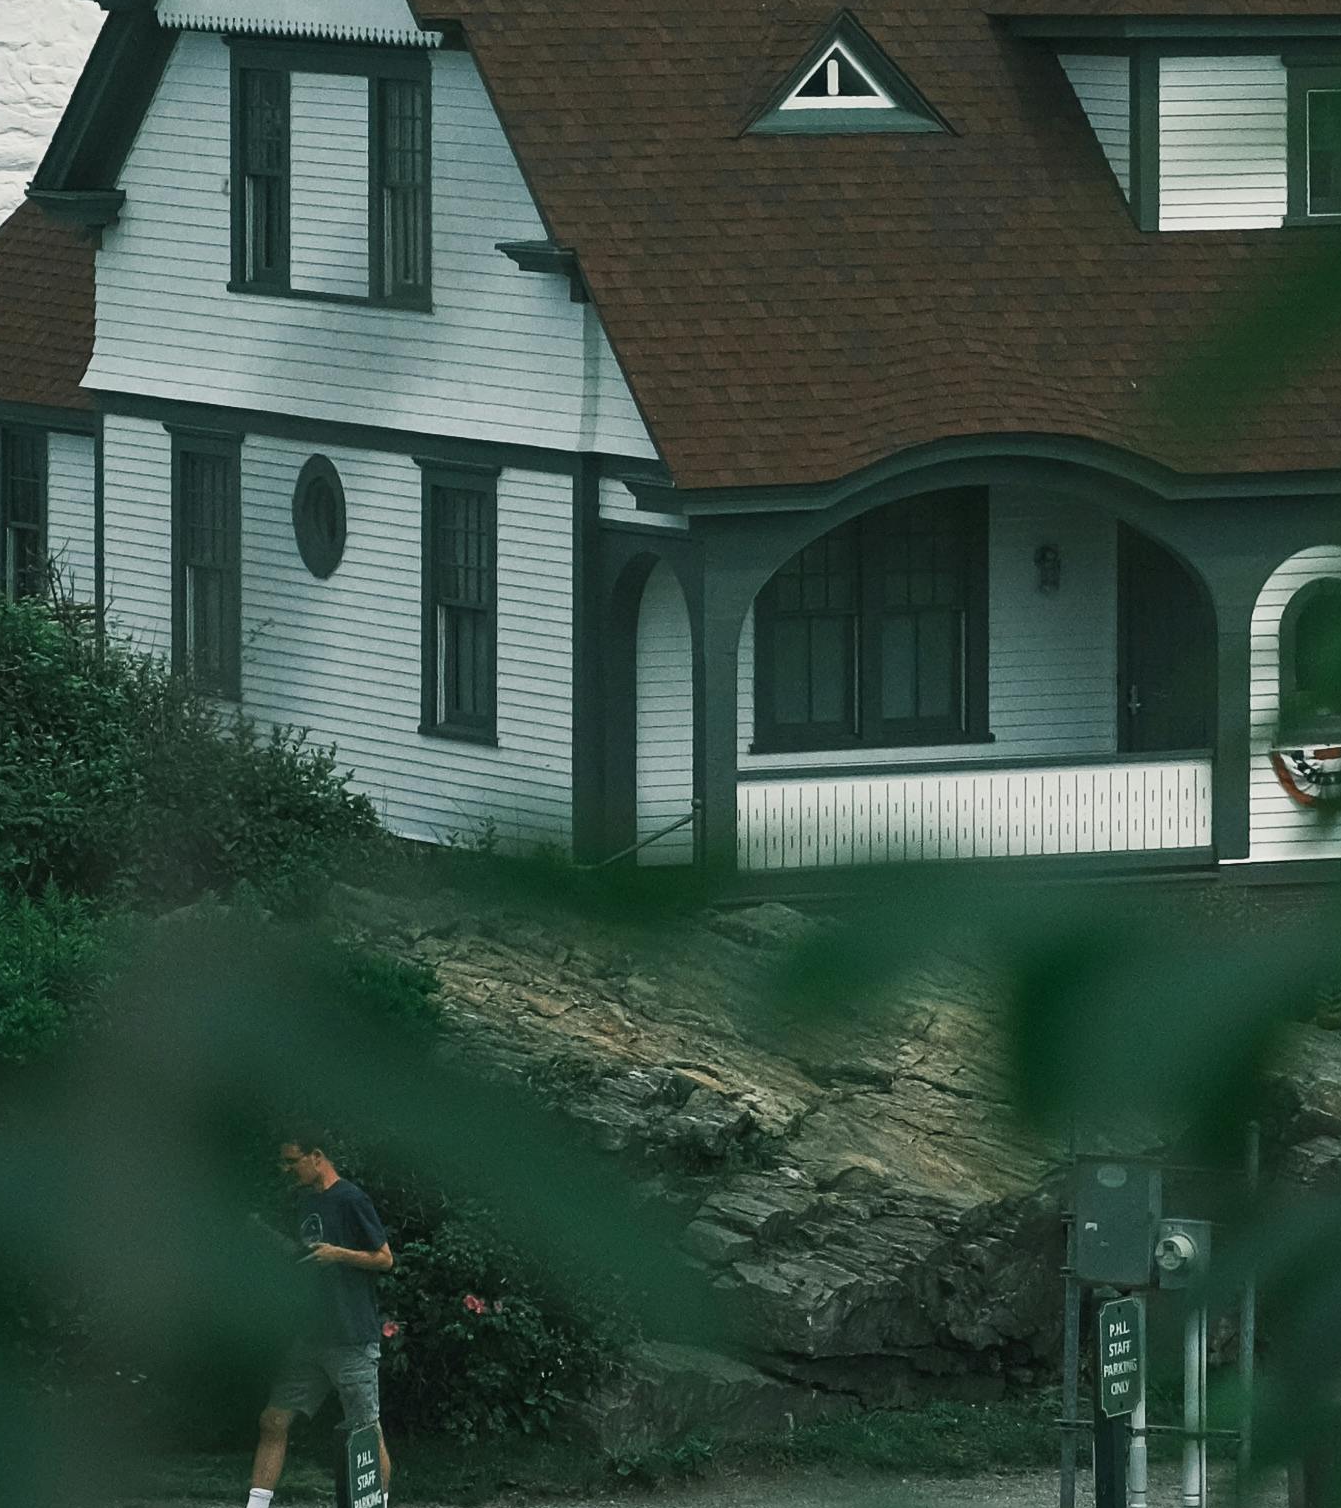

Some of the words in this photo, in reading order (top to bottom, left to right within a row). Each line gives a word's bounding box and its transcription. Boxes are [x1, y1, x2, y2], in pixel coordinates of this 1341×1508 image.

[1109, 1340, 1132, 1357] STAFF
[1103, 1358, 1137, 1378] PARKING
[1111, 1379, 1130, 1395] ONLY
[357, 1470, 376, 1491] STAFF
